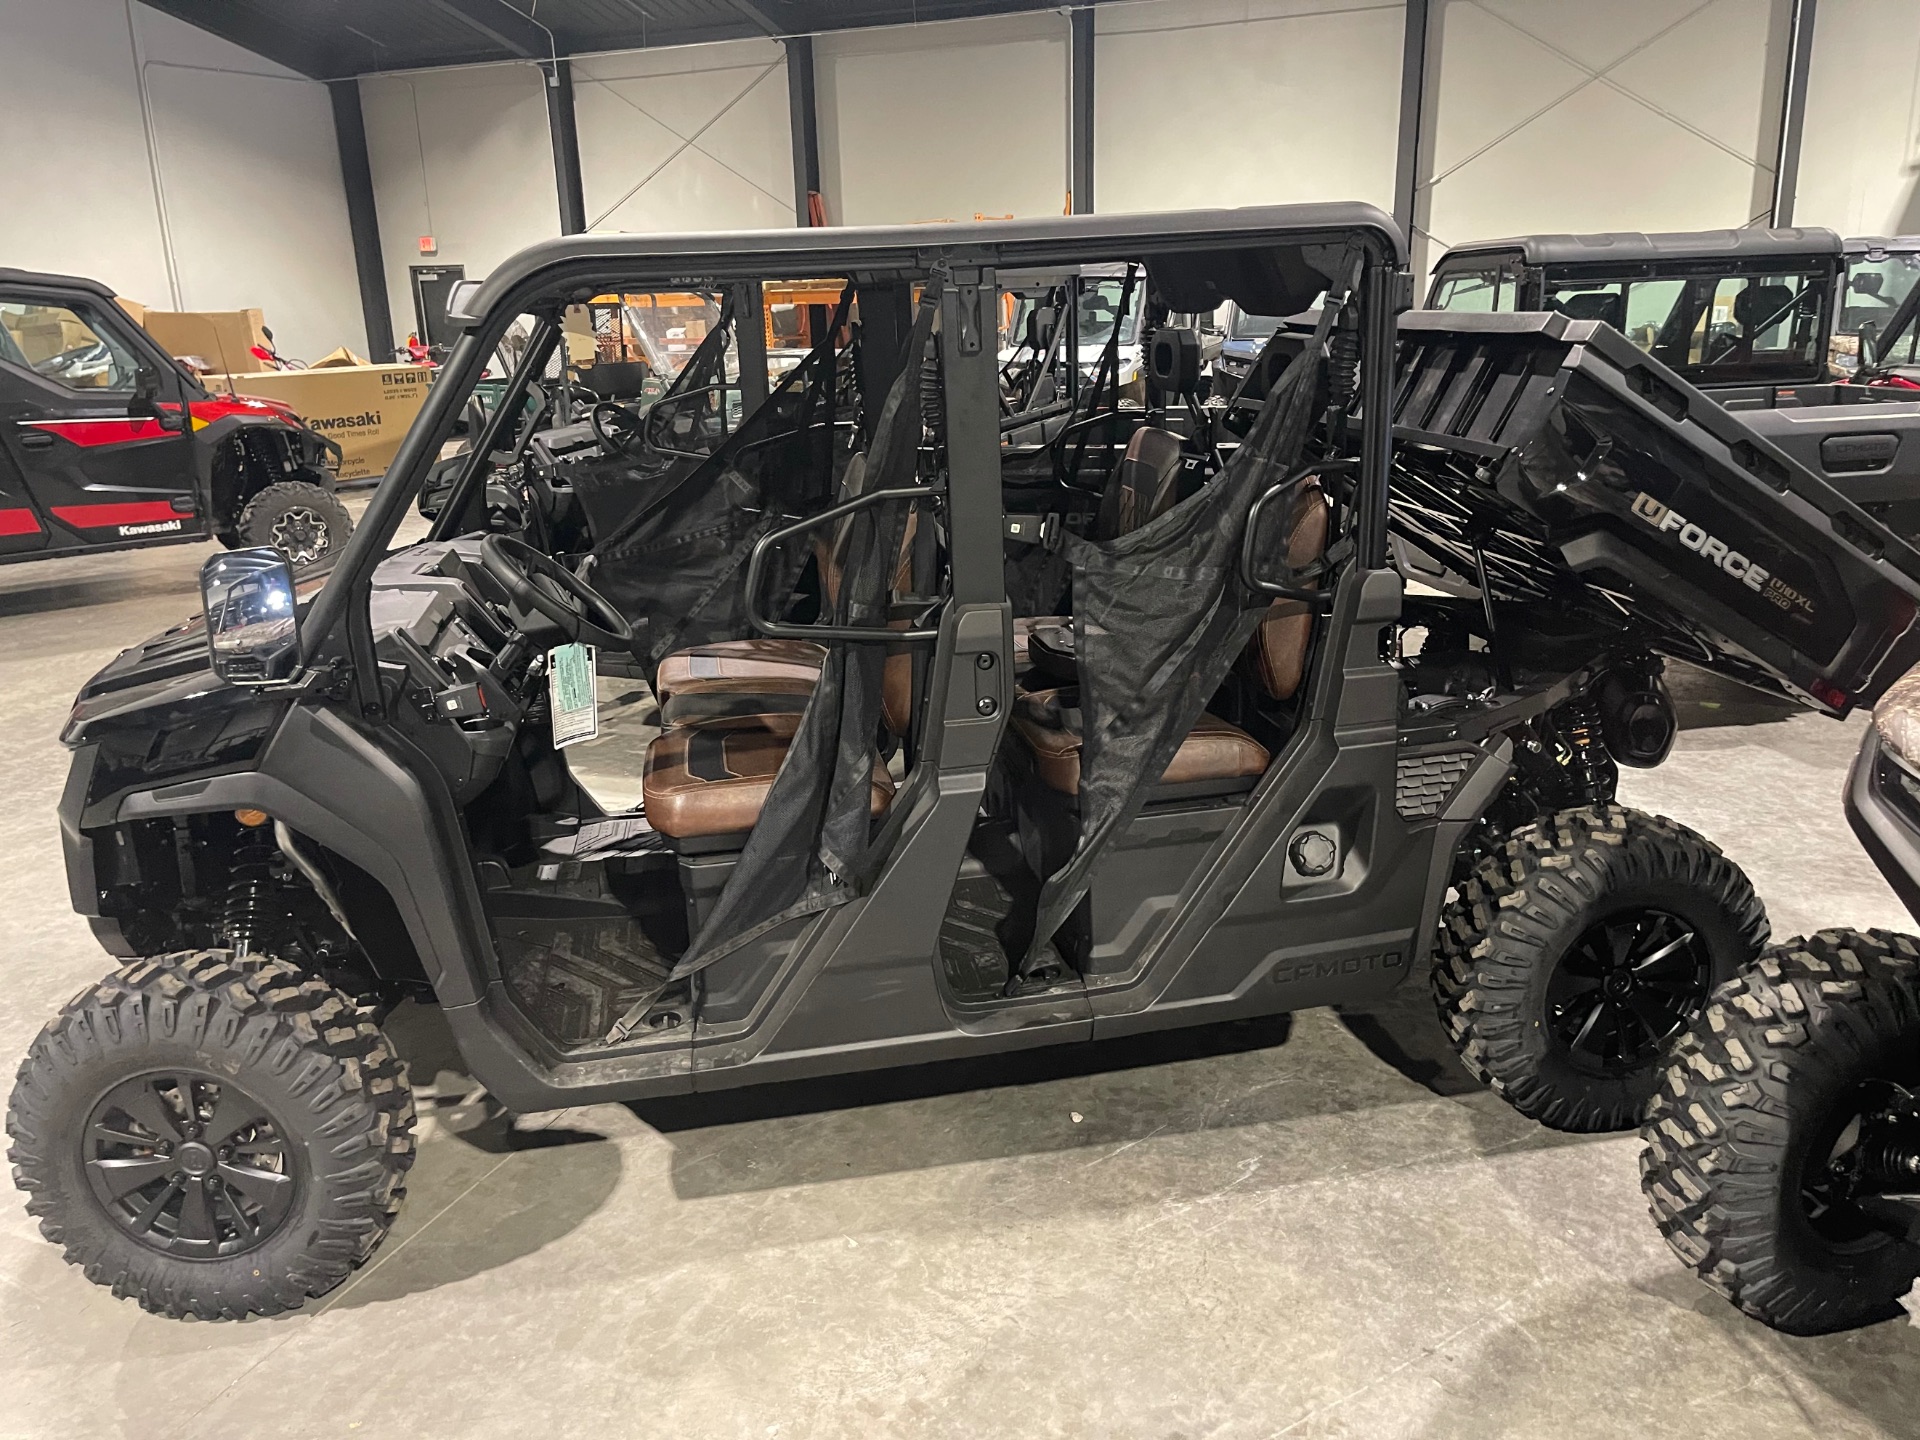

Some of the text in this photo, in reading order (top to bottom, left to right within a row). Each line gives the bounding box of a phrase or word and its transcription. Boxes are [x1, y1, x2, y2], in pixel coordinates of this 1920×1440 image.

[328, 428, 380, 440] Good Times Roll
[118, 519, 182, 536] Kawasaki
[1631, 491, 1770, 592] UFORCE
[1763, 587, 1791, 610] PRO
[1272, 951, 1403, 985] CFMOTO
